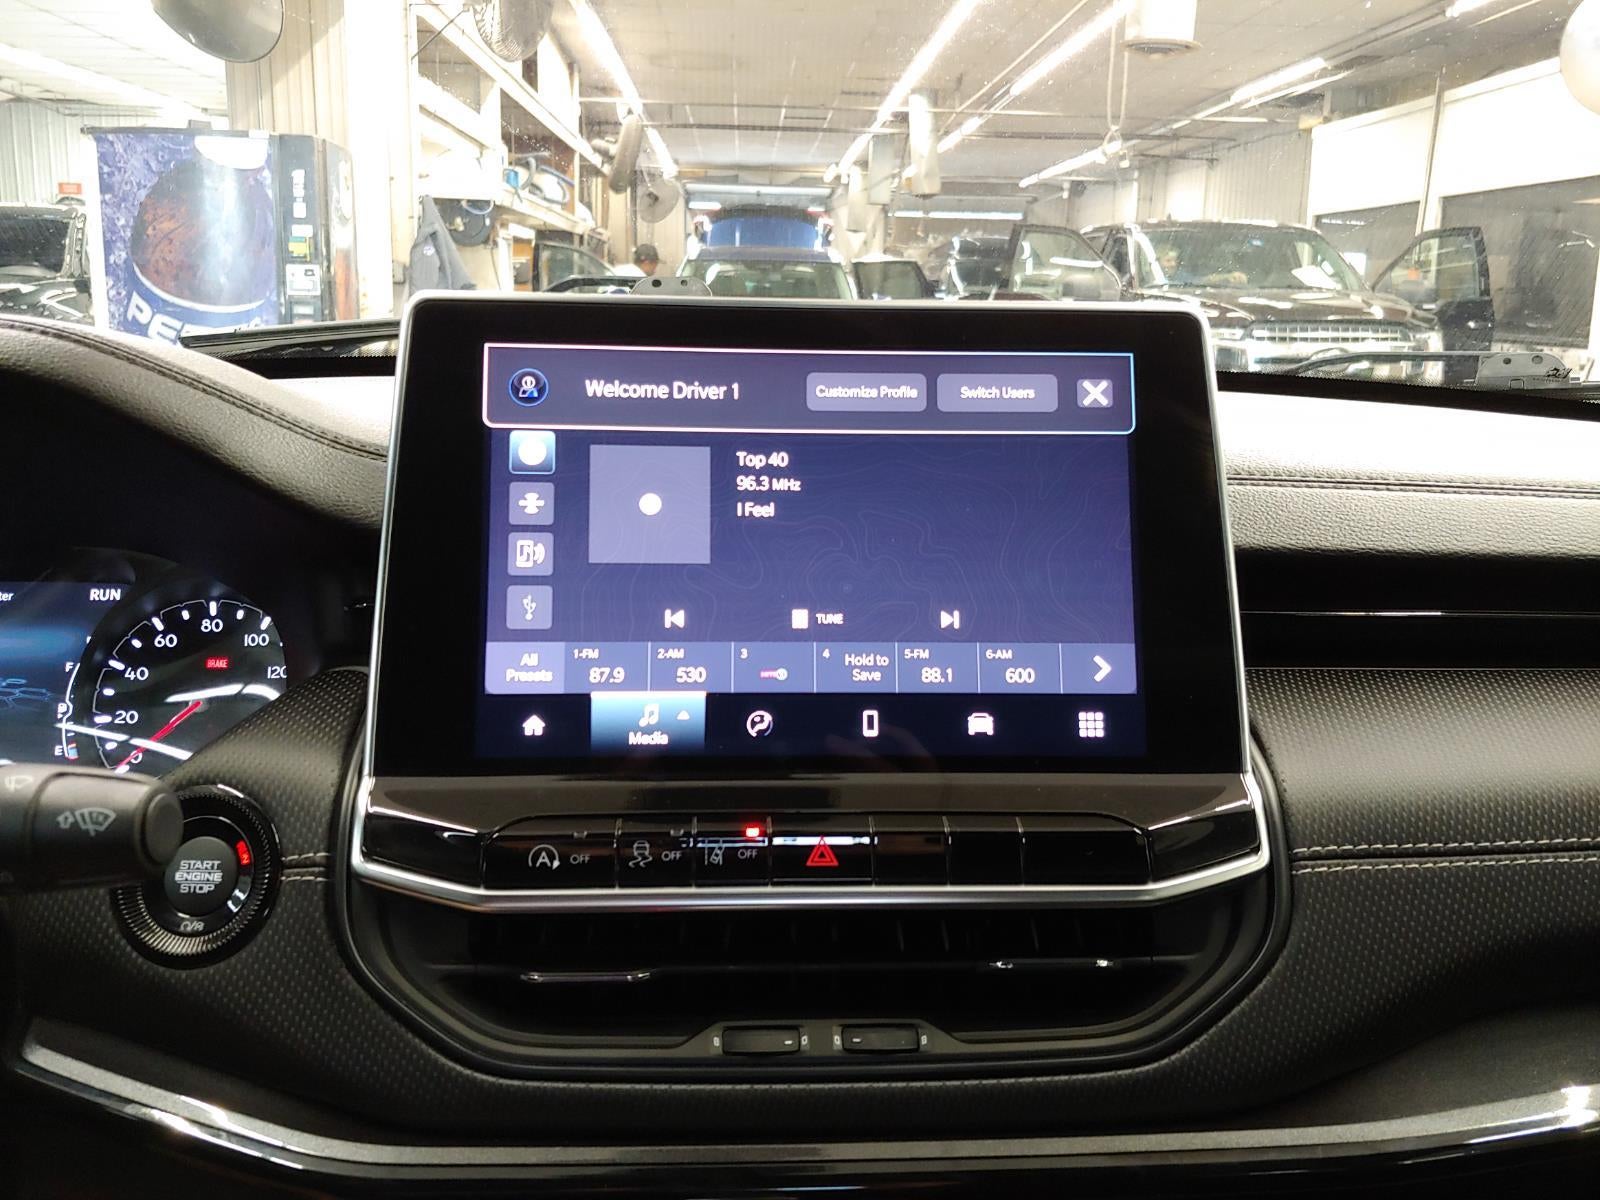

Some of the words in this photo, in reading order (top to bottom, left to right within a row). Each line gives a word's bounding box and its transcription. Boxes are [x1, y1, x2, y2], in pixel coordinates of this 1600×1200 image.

[585, 379, 669, 399] Welcome
[672, 381, 726, 400] Driver
[731, 383, 740, 400] 1
[815, 384, 878, 399] Customize
[880, 384, 918, 399] Profile
[960, 386, 1000, 399] Switch
[1002, 386, 1035, 399] Users
[736, 451, 766, 469] Top
[768, 452, 789, 468] 40
[736, 476, 769, 492] 96.3
[772, 479, 801, 492] MHz
[745, 502, 775, 518] Feel
[89, 588, 122, 601] RUN
[200, 618, 223, 633] 80
[815, 613, 844, 625] TUNE
[154, 634, 177, 648] 60
[243, 633, 269, 647] 100
[520, 653, 538, 666] All
[657, 648, 684, 660] 2-AM
[740, 648, 748, 659] 3
[822, 648, 830, 659] 4
[844, 653, 874, 667] Hold
[876, 654, 889, 667] to
[904, 648, 930, 659] 5-FM
[985, 649, 1013, 660] 6-AM
[65, 661, 74, 673] F
[206, 659, 228, 668] BRAKE
[124, 665, 149, 681] 40
[505, 668, 553, 683] Presets
[588, 666, 625, 684] 87.9
[676, 667, 706, 684] 530
[851, 668, 882, 682] Save
[921, 667, 953, 683] 88.1
[1004, 668, 1036, 684] 600
[114, 710, 139, 724] 20
[628, 731, 669, 746] Media
[54, 745, 63, 756] E
[570, 854, 591, 865] OFF
[661, 851, 683, 862] OFF
[737, 848, 759, 860] OFF
[180, 860, 222, 870] START
[174, 871, 223, 882] ENGINE
[180, 883, 215, 894] STOP
